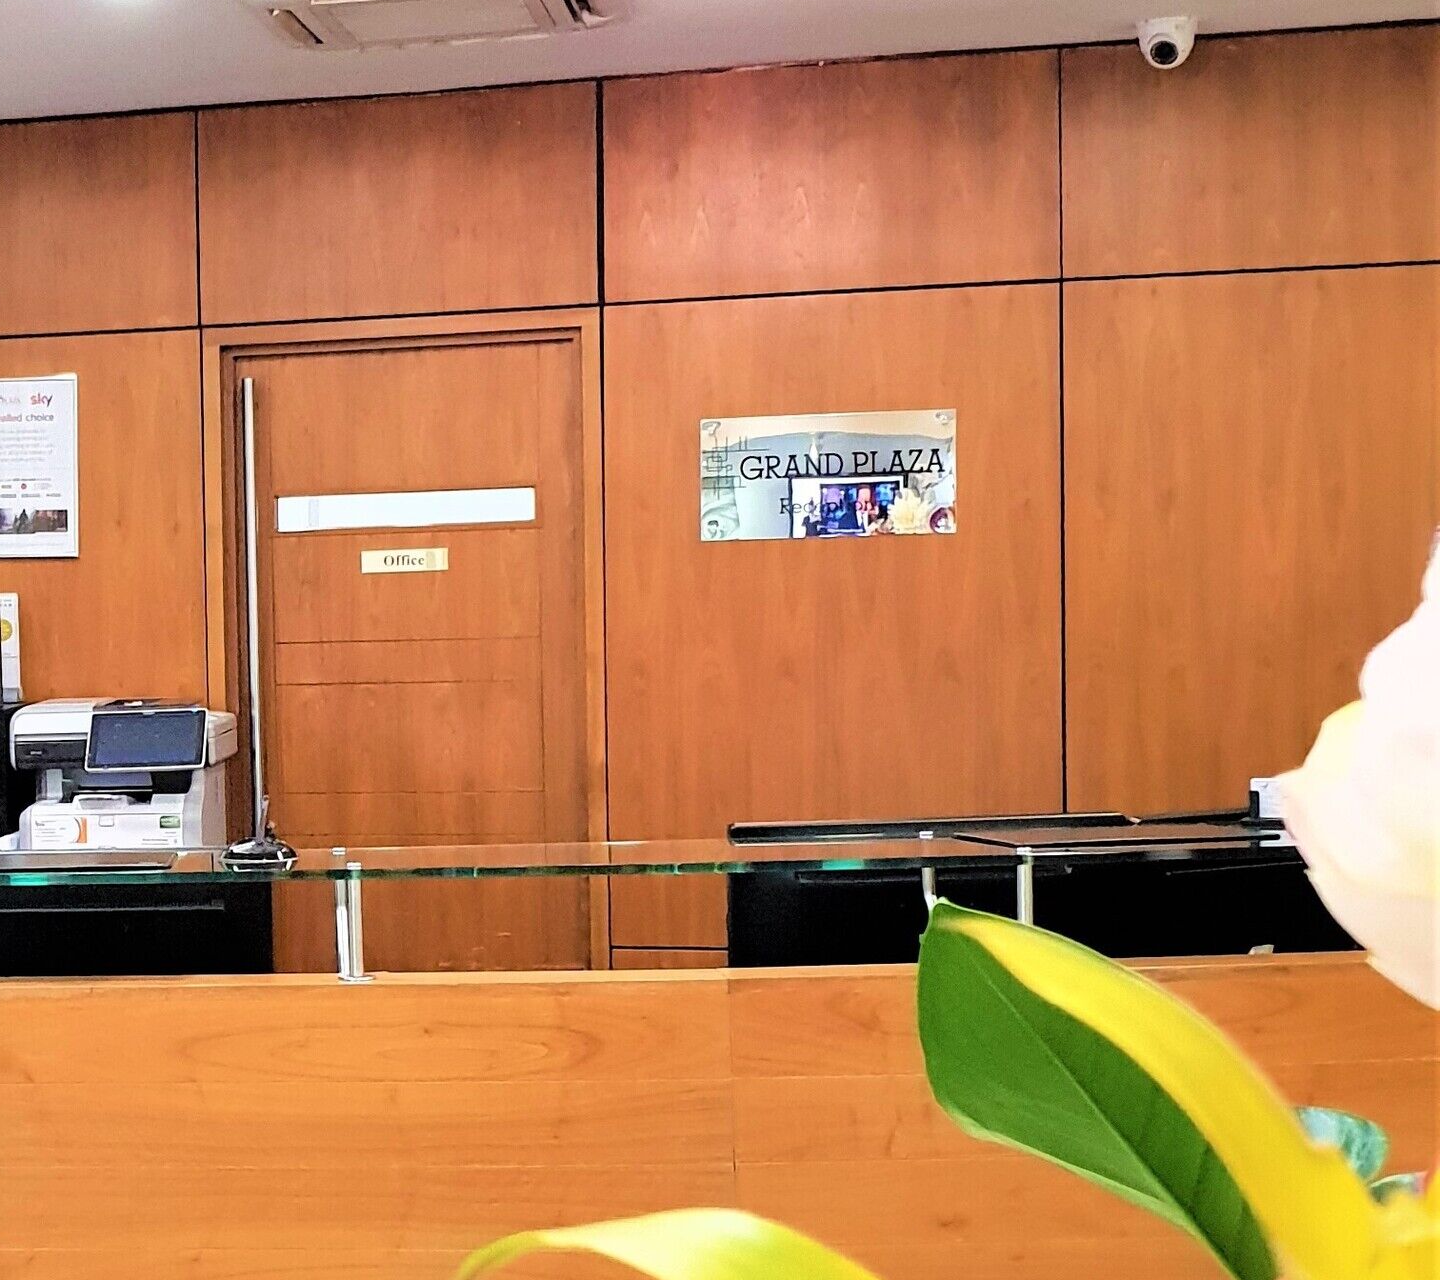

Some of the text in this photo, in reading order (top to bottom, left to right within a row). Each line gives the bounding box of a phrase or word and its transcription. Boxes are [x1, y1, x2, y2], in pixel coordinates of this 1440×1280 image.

[30, 392, 53, 407] sky
[25, 413, 54, 422] choice
[740, 448, 945, 480] GRAND PLAZA
[384, 554, 425, 567] Office
